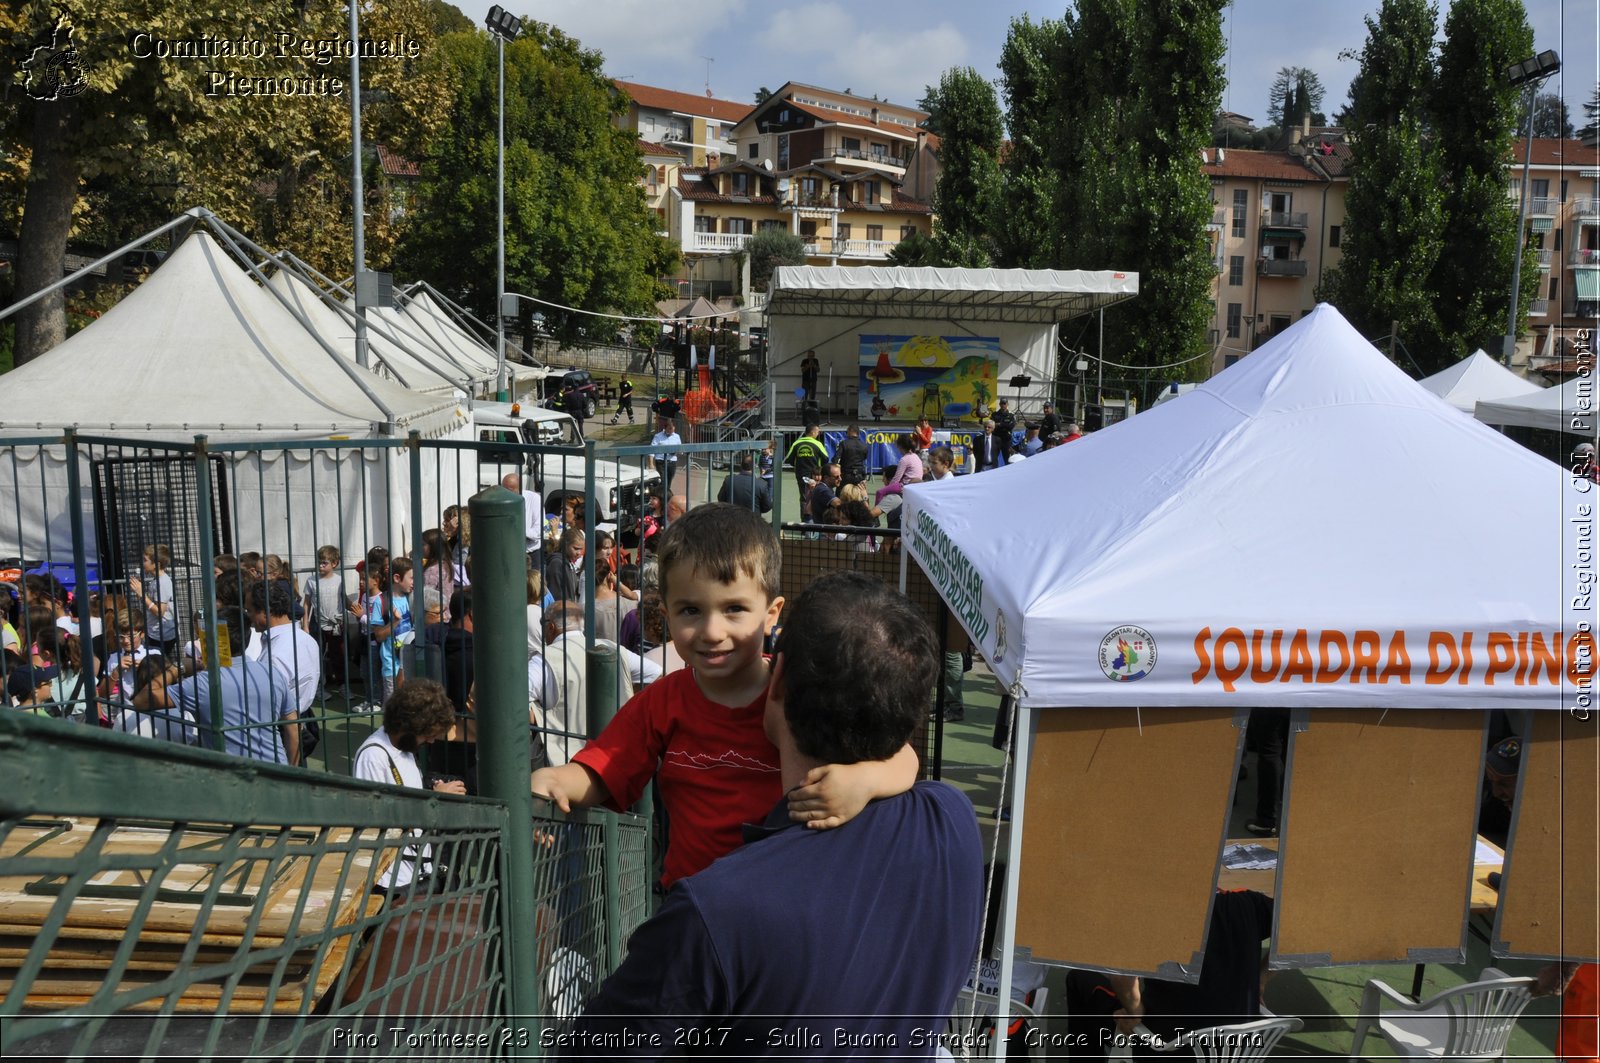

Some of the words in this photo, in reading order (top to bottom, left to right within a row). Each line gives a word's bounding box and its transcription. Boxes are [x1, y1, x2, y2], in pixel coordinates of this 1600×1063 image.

[917, 509, 939, 547] CORPO
[938, 528, 984, 609] VOLONTARI
[1103, 628, 1133, 647] VOLONTARI
[1145, 637, 1156, 667] PIEMONTE
[1101, 648, 1109, 668] CORPO
[1191, 626, 1411, 692] SQUADRA
[1425, 631, 1474, 686] DI
[1484, 631, 1599, 686] PINO
